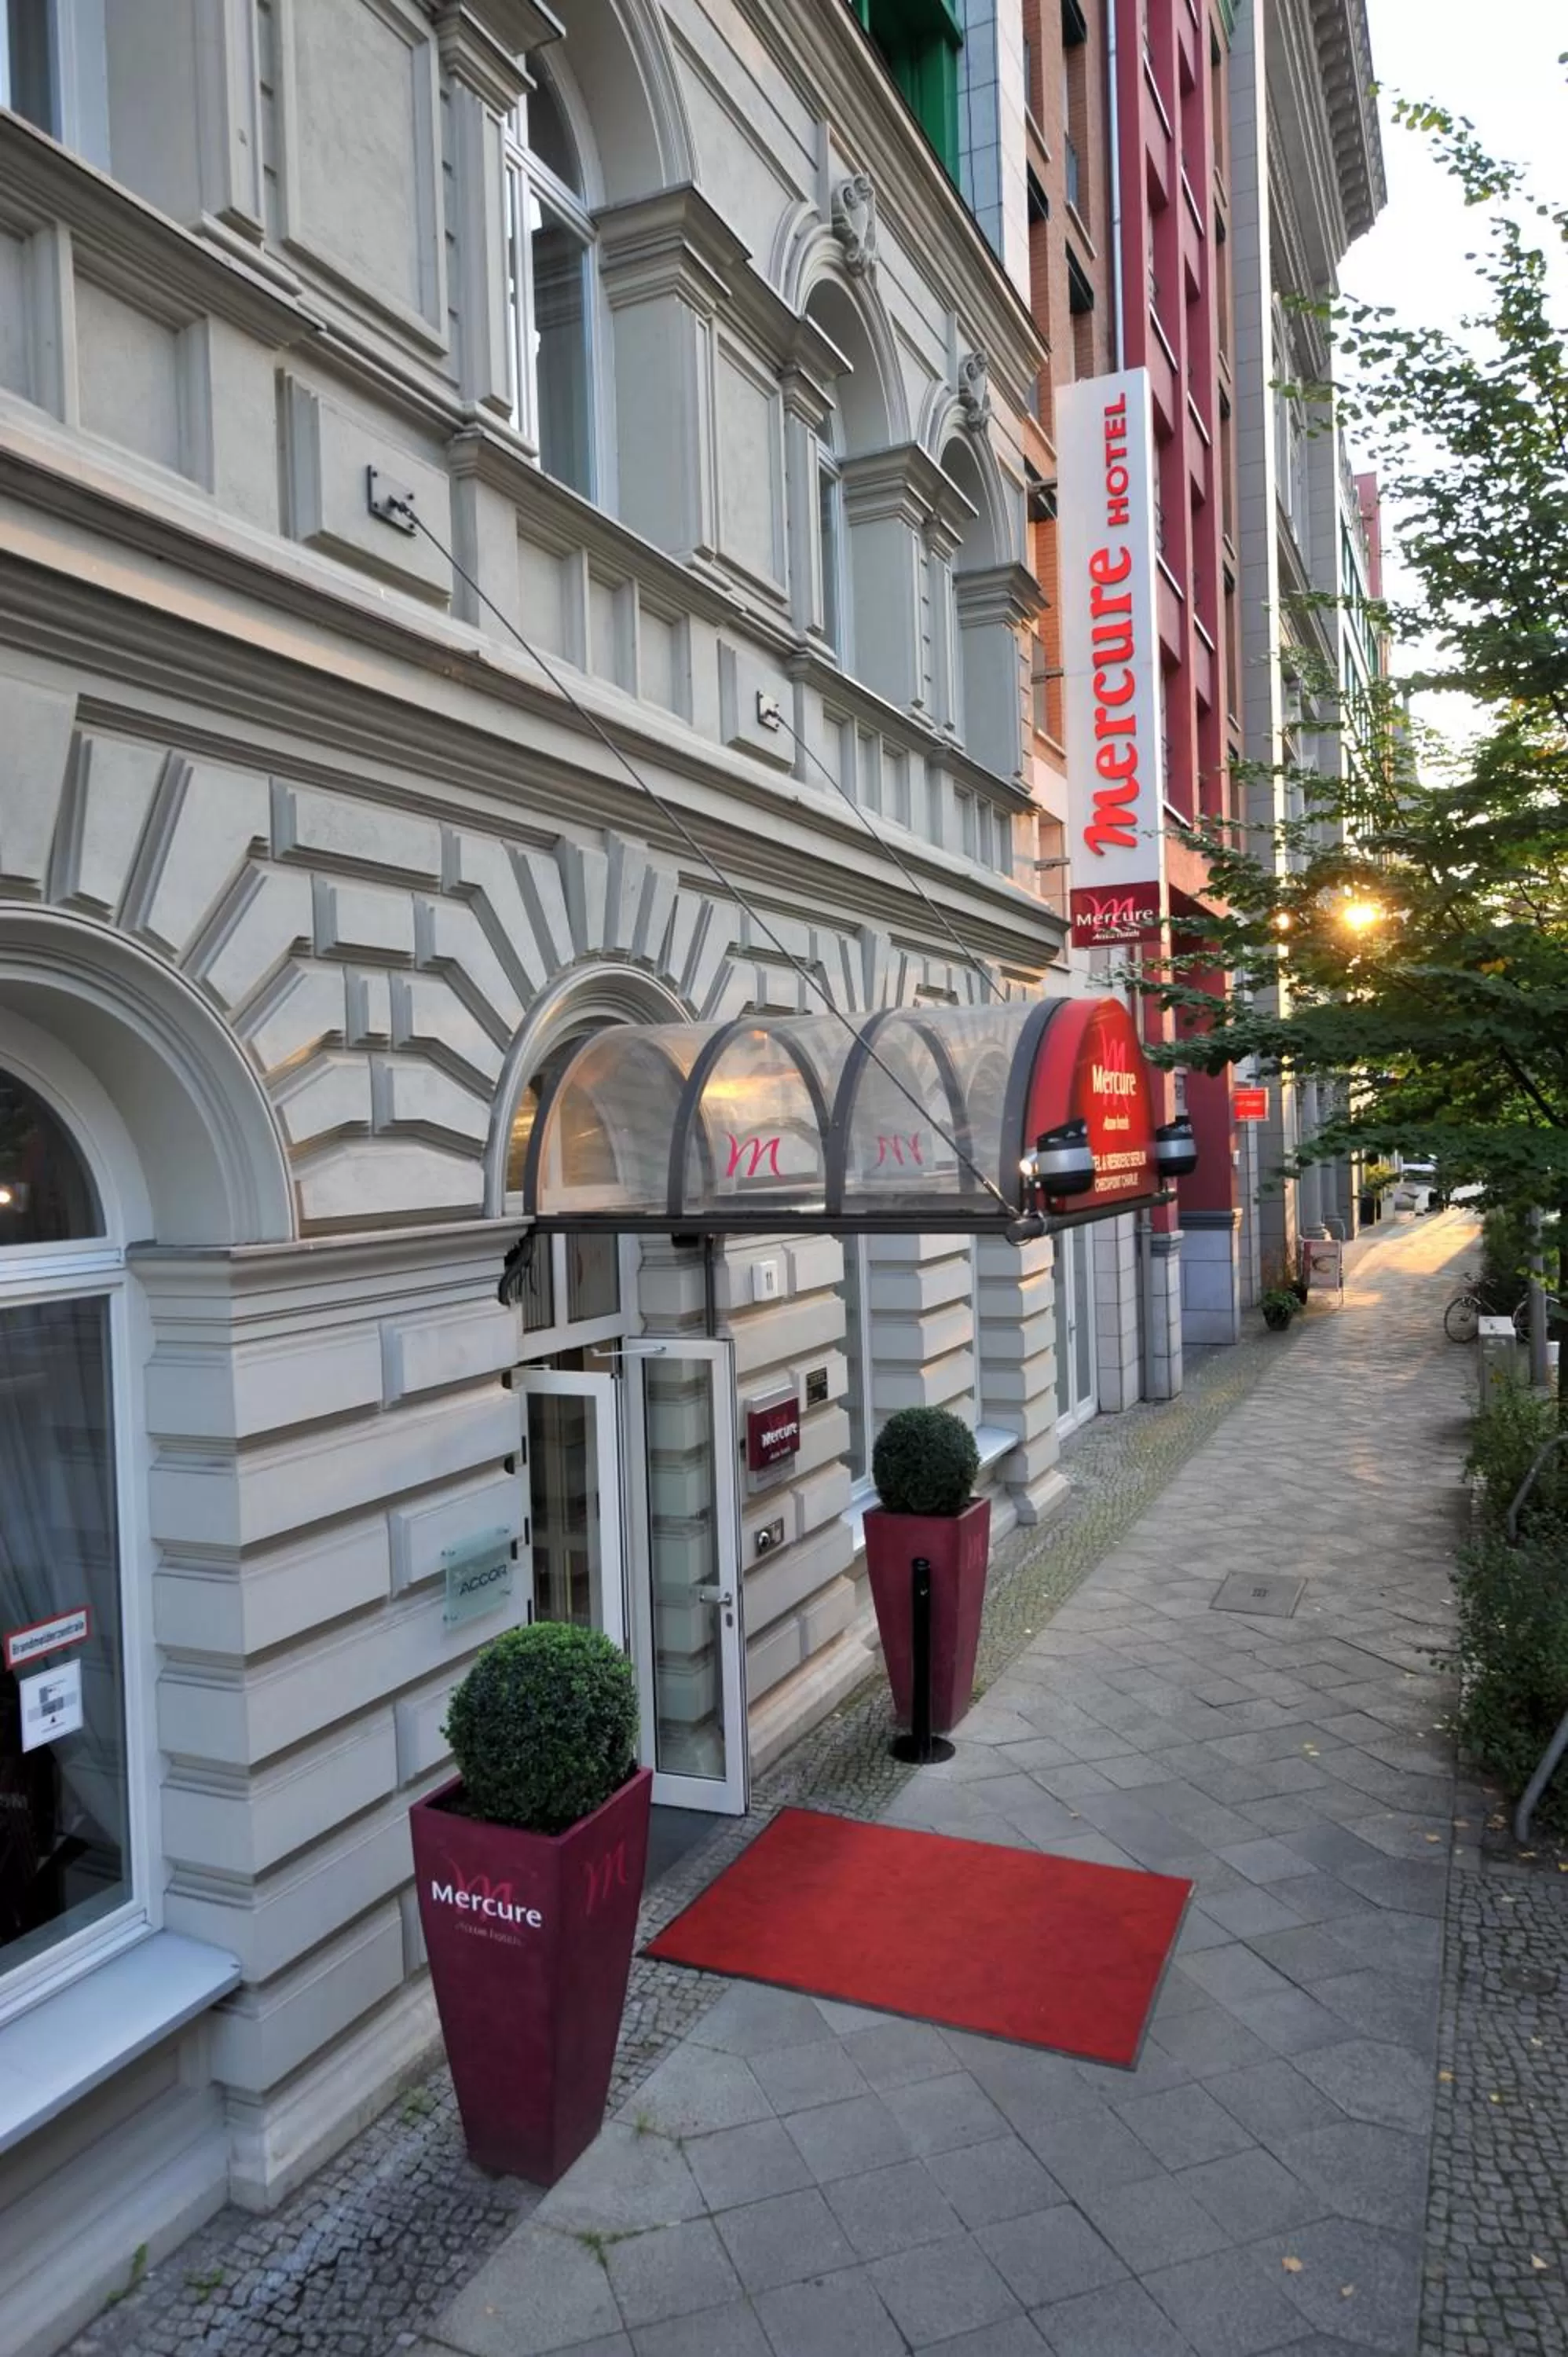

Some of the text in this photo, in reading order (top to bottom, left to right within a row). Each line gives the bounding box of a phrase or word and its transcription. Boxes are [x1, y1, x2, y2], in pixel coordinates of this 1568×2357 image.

[1104, 392, 1130, 527] HOTEL
[1075, 909, 1154, 927] Mercure
[1091, 1063, 1138, 1097] Mercure
[760, 1422, 798, 1448] Mercure
[430, 1879, 543, 1928] Mercure
